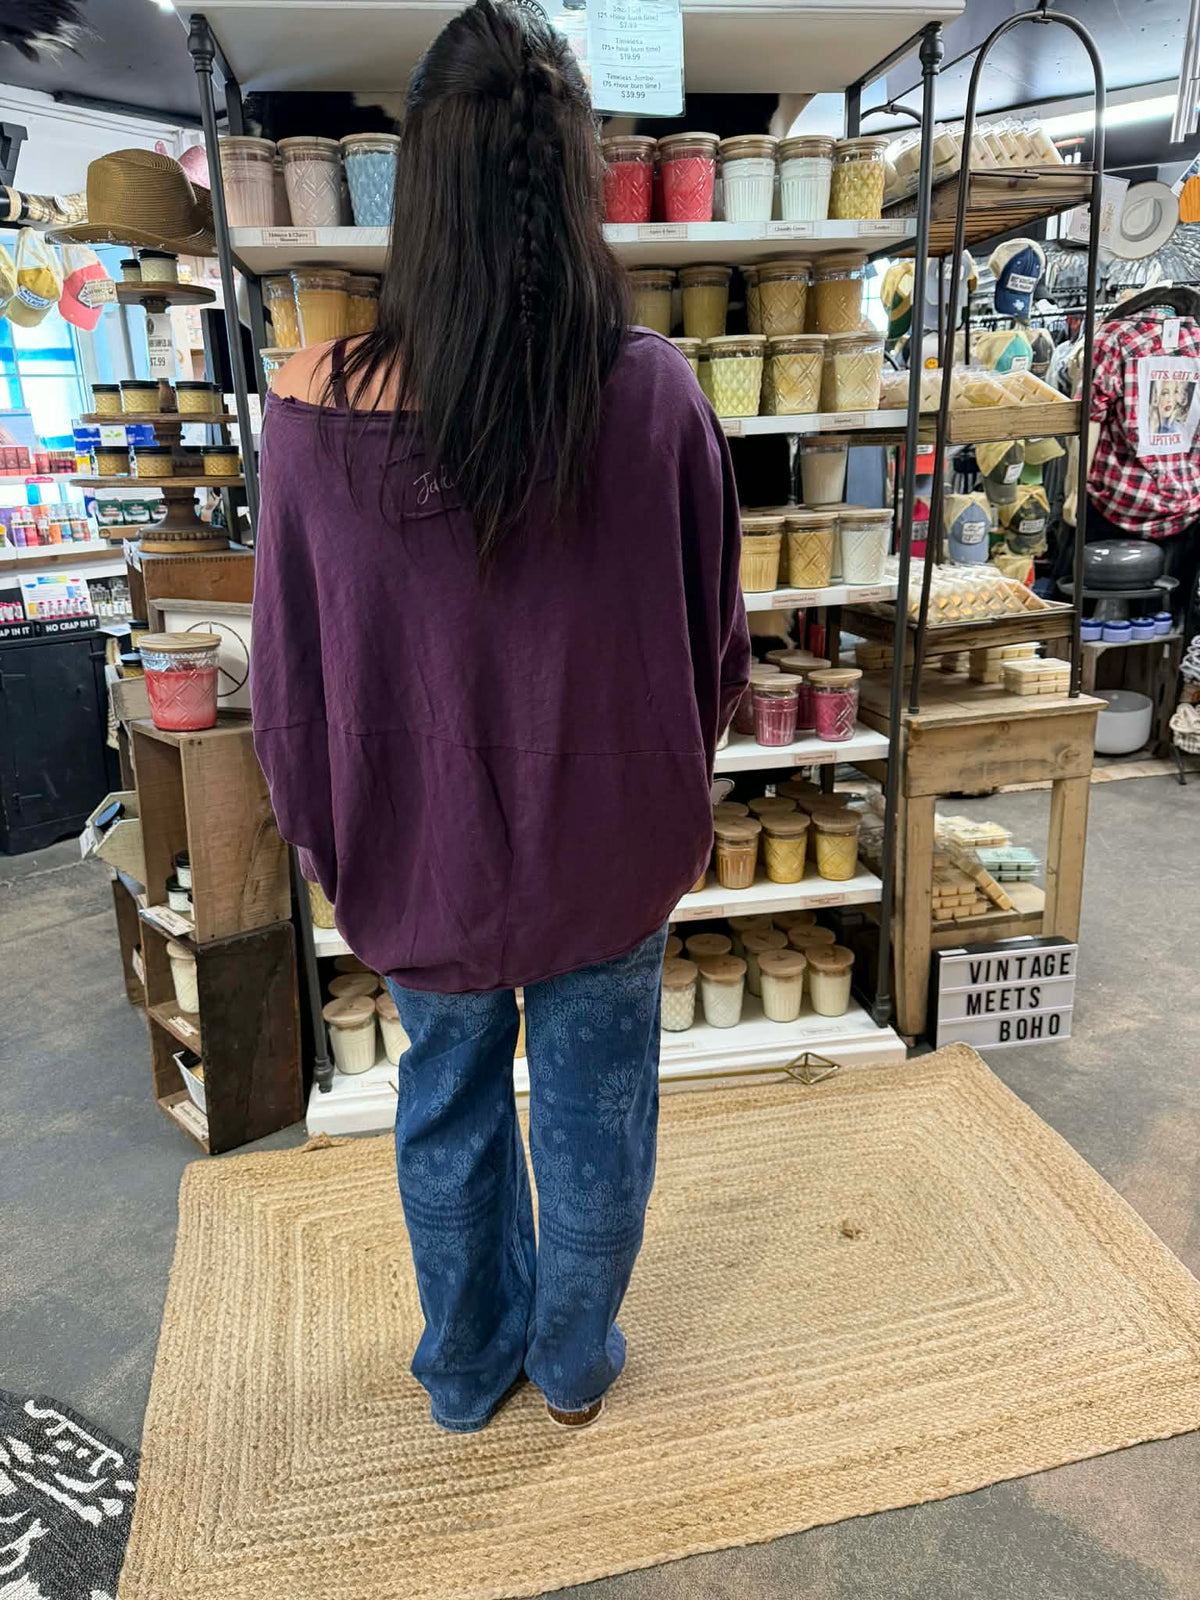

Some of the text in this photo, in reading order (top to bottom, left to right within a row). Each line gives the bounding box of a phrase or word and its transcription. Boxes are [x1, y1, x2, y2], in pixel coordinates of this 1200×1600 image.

[621, 90, 646, 99] $39.99
[11, 628, 21, 636] IN
[22, 626, 31, 635] IT
[45, 619, 97, 633] NO CRAP IN IT
[969, 952, 1072, 984] VINTAGE
[966, 986, 1041, 1016] MEETS
[1000, 1013, 1060, 1042] BOHO
